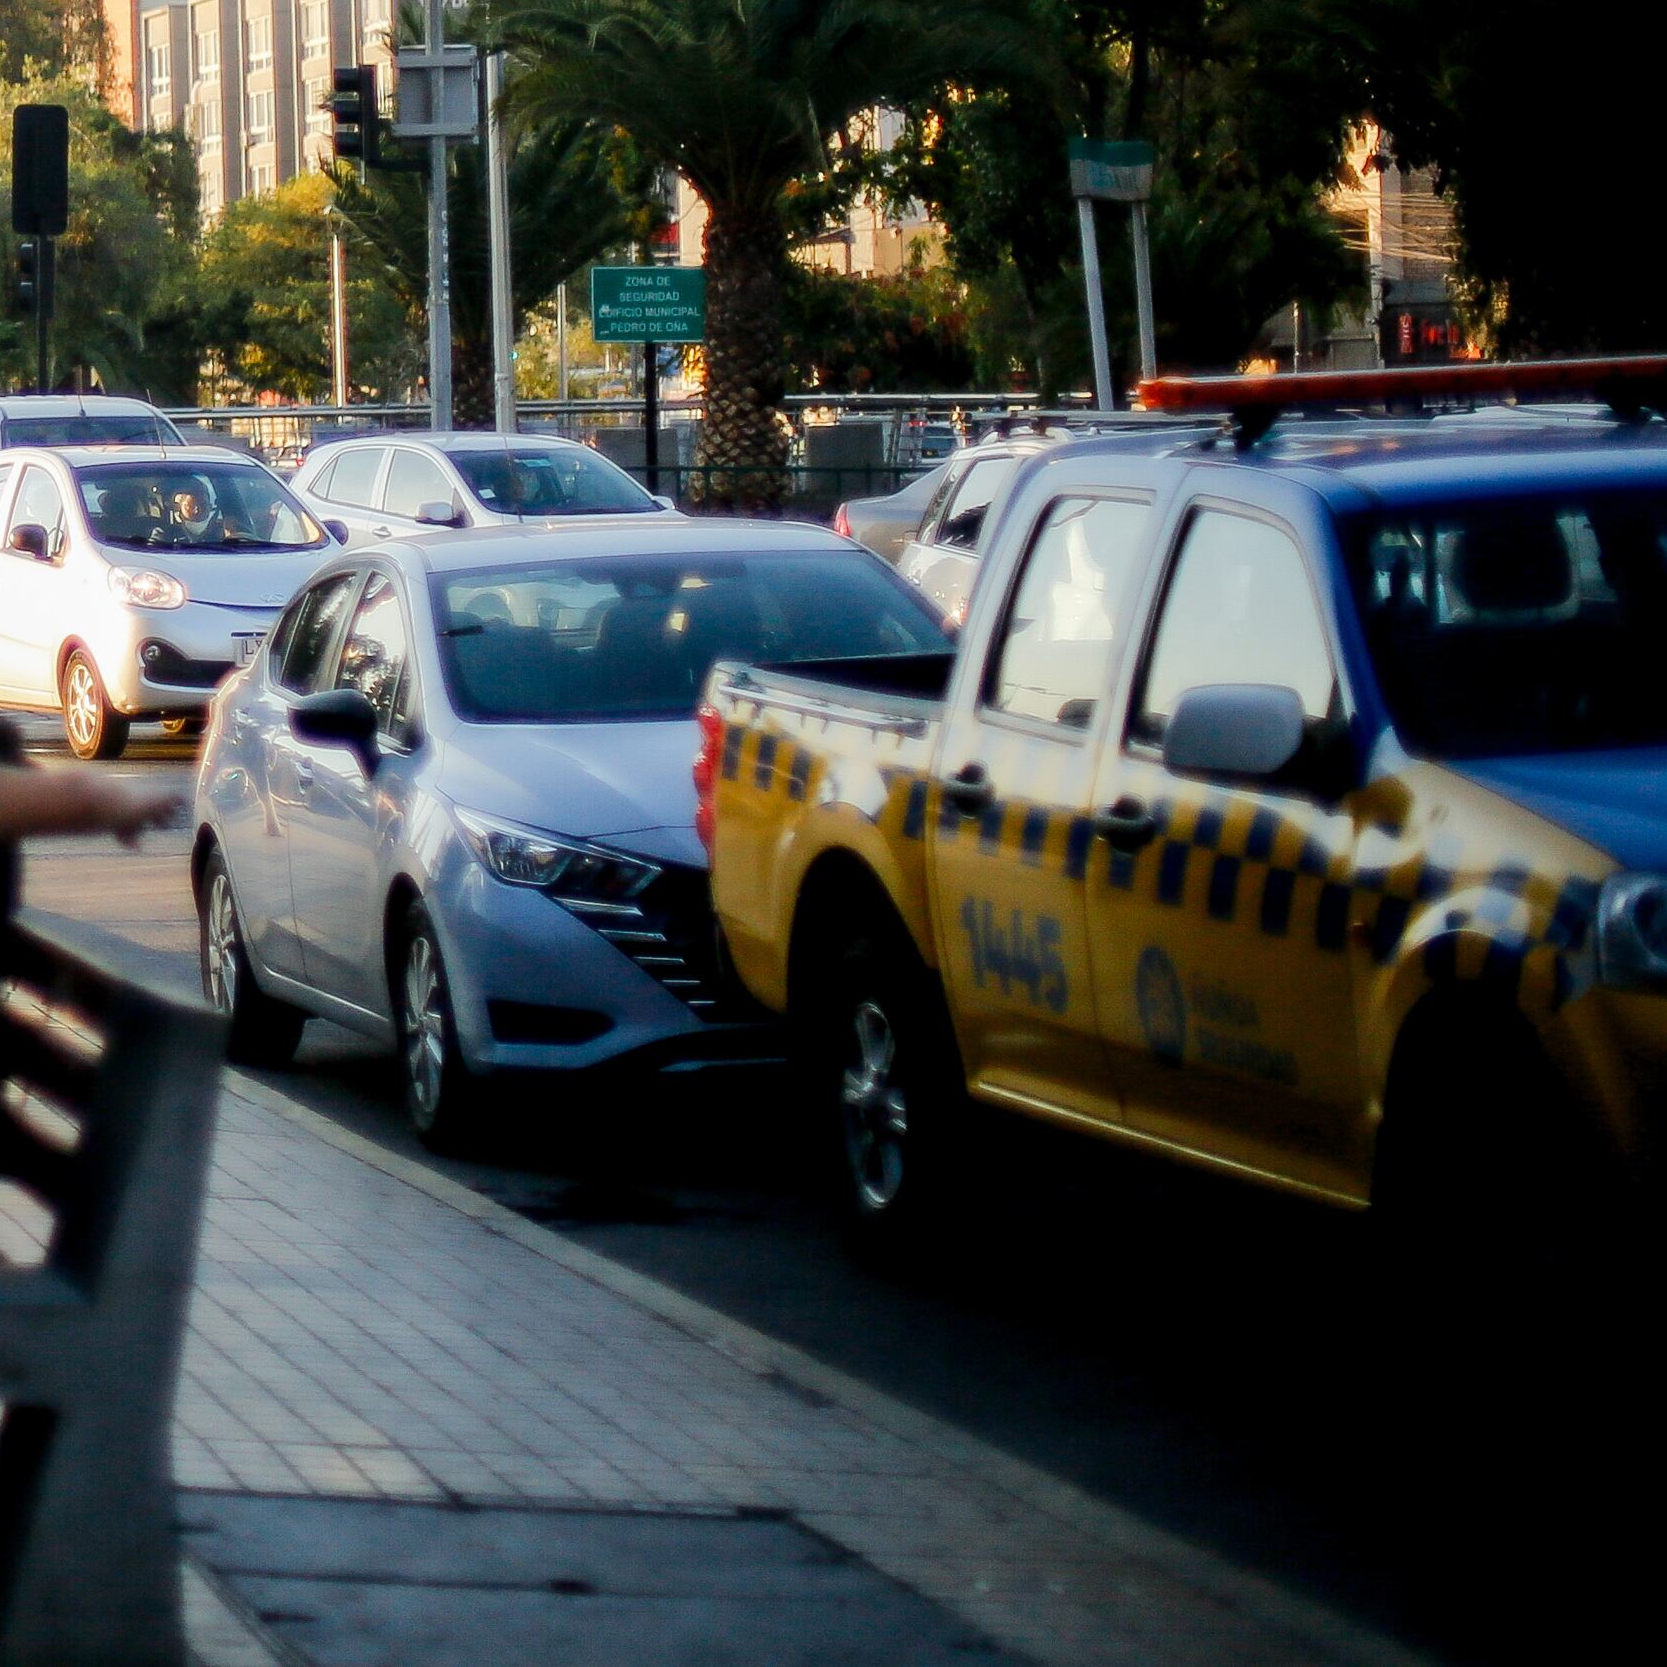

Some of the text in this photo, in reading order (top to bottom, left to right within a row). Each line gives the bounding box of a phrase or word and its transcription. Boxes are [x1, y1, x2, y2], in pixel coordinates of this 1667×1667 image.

[625, 276, 671, 287] ZONA DE
[619, 291, 680, 302] SEGURIDAD
[645, 306, 701, 317] MUNICIPAL
[610, 320, 689, 333] PEDRO DE OÑA
[960, 894, 1068, 1014] 1445
